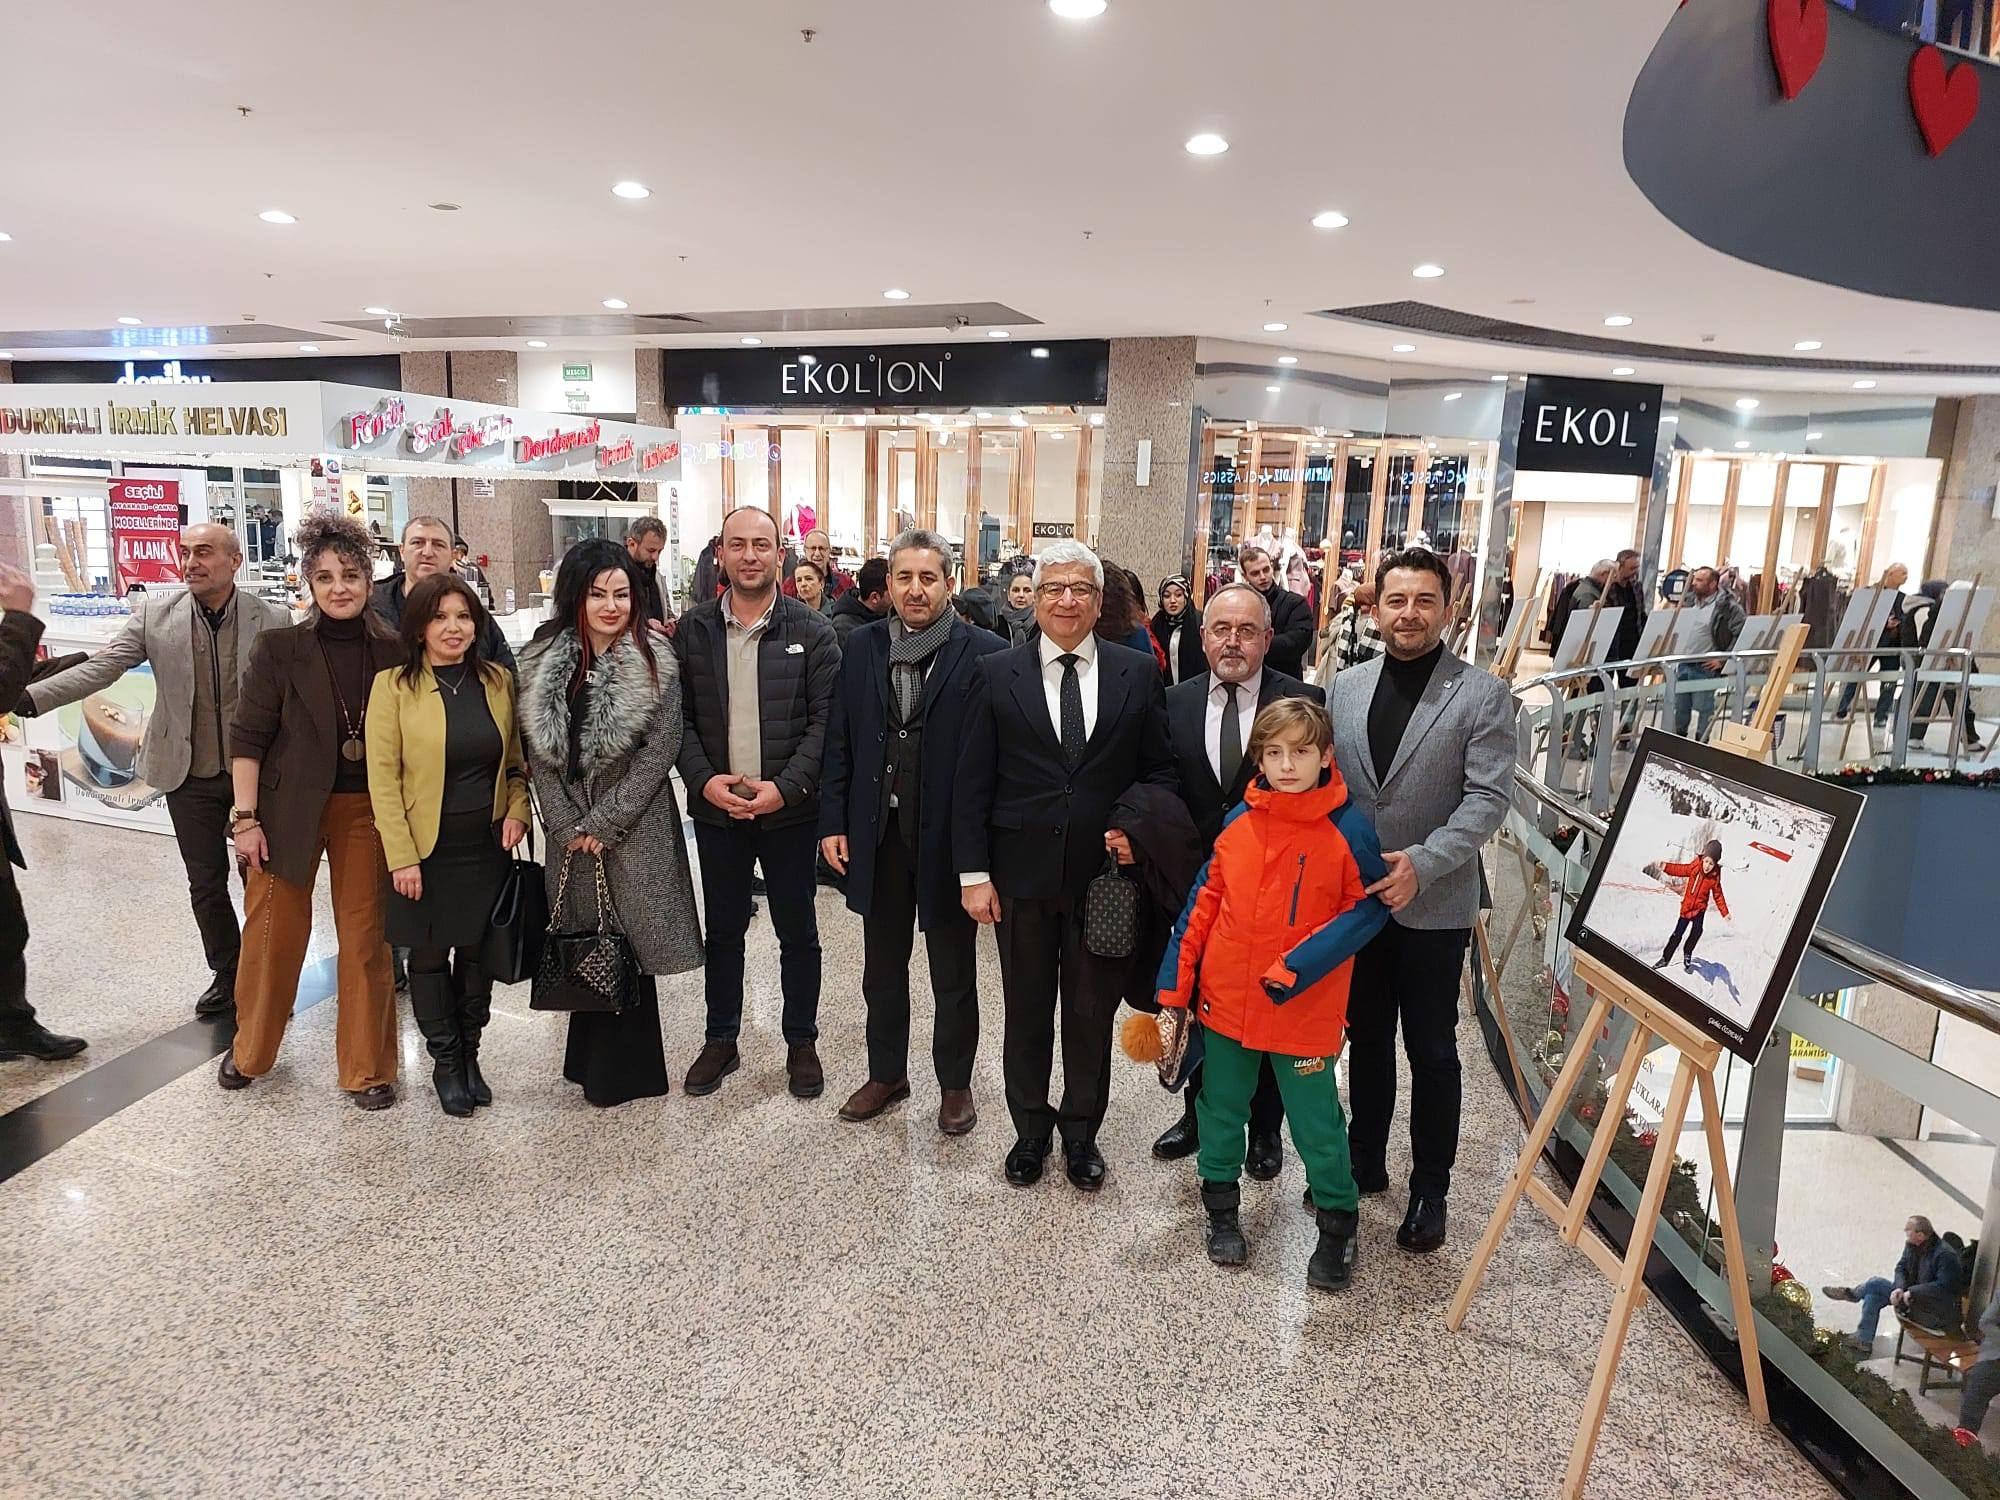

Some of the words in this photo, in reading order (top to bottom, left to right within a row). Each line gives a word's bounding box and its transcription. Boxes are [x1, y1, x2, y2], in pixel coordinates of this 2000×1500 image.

[0, 407, 102, 434] DURMALI
[108, 400, 178, 435] İRMİK
[183, 406, 287, 436] HELVASI
[1535, 404, 1638, 447] EKOL
[125, 485, 164, 500] SEÇİLİ
[115, 515, 179, 531] MODELLERİNDE
[124, 540, 131, 559] 1
[133, 541, 169, 560] ALANA
